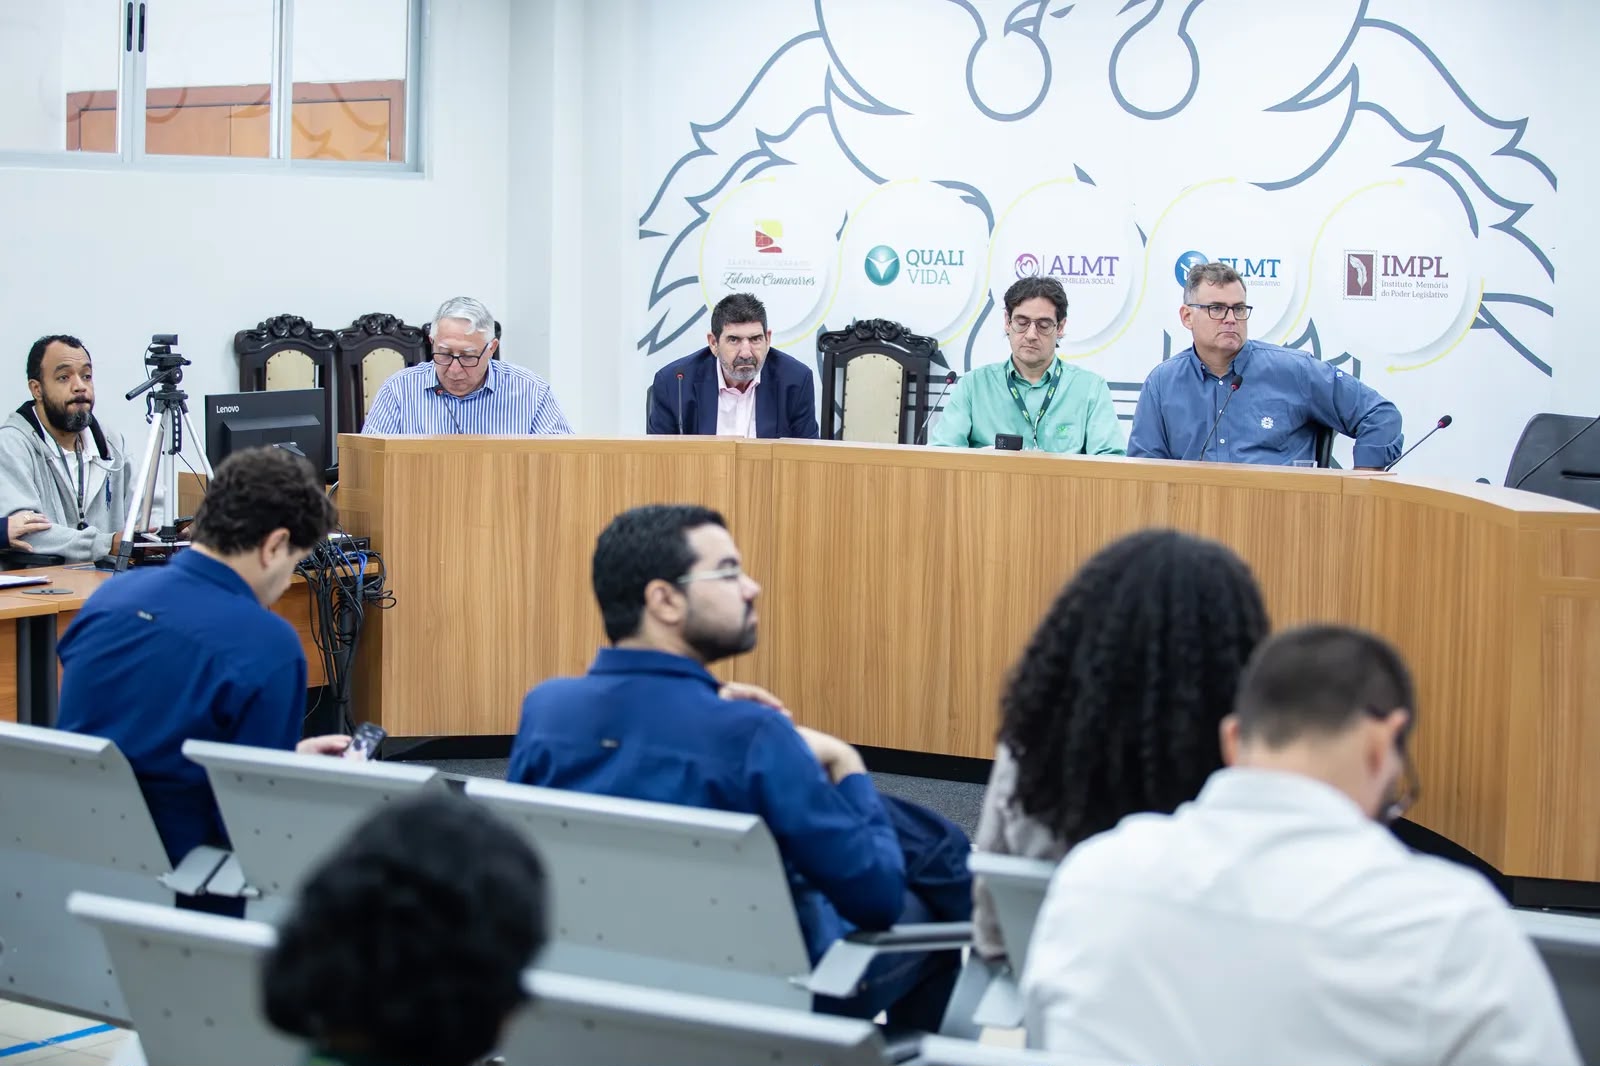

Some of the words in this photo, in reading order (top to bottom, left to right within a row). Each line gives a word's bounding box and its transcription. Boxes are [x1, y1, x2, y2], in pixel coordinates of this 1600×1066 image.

[906, 249, 964, 267] QUALI
[1048, 255, 1119, 276] ALMT
[1382, 255, 1449, 278] IMPL
[907, 269, 950, 284] VIDA
[1218, 257, 1281, 278] LMT
[724, 272, 760, 290] Zulmira
[1381, 280, 1413, 288] Instituto
[1391, 290, 1411, 298] Poder
[1412, 291, 1449, 299] Legislativo
[216, 405, 240, 414] Lenovo
